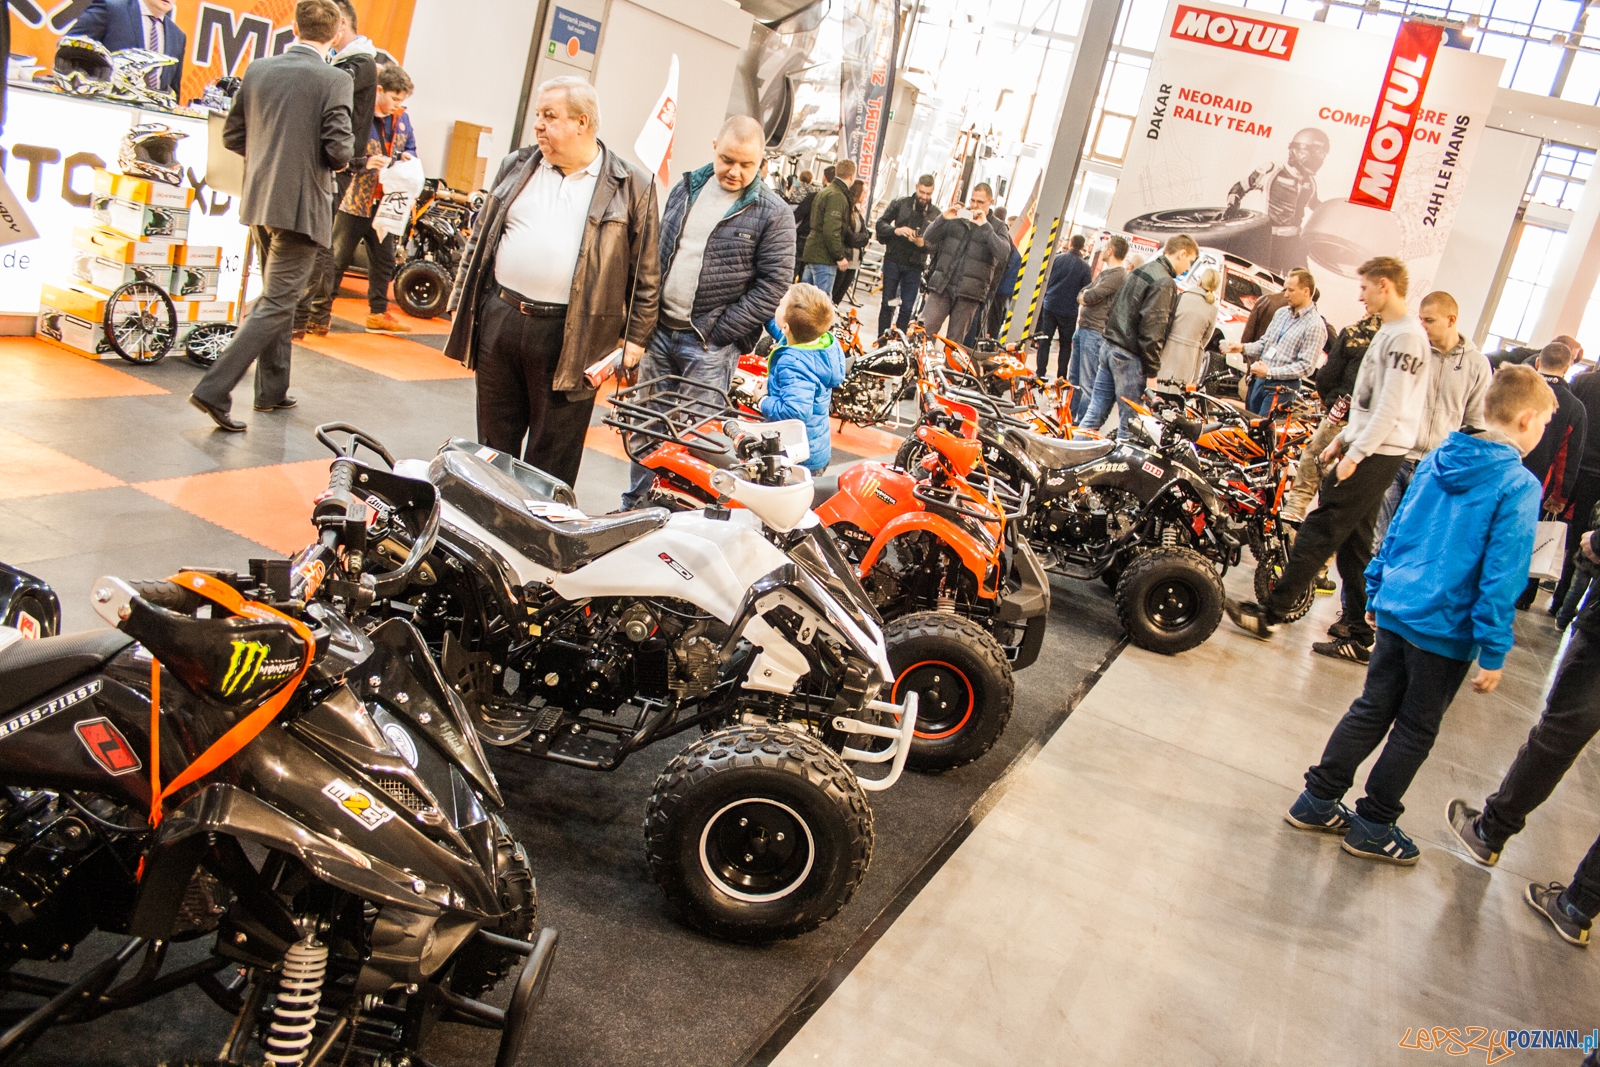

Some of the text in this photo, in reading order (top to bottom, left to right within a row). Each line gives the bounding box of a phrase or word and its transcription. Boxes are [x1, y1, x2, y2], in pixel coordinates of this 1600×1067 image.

[1175, 10, 1288, 55] MOTUL
[1146, 83, 1173, 140] DAKAR
[1173, 105, 1273, 138] RALLY TEAM
[1177, 87, 1253, 114] NEORAID
[1358, 53, 1428, 204] MOTUL
[1422, 114, 1471, 228] 24H LE MANS
[1143, 463, 1163, 477] DID
